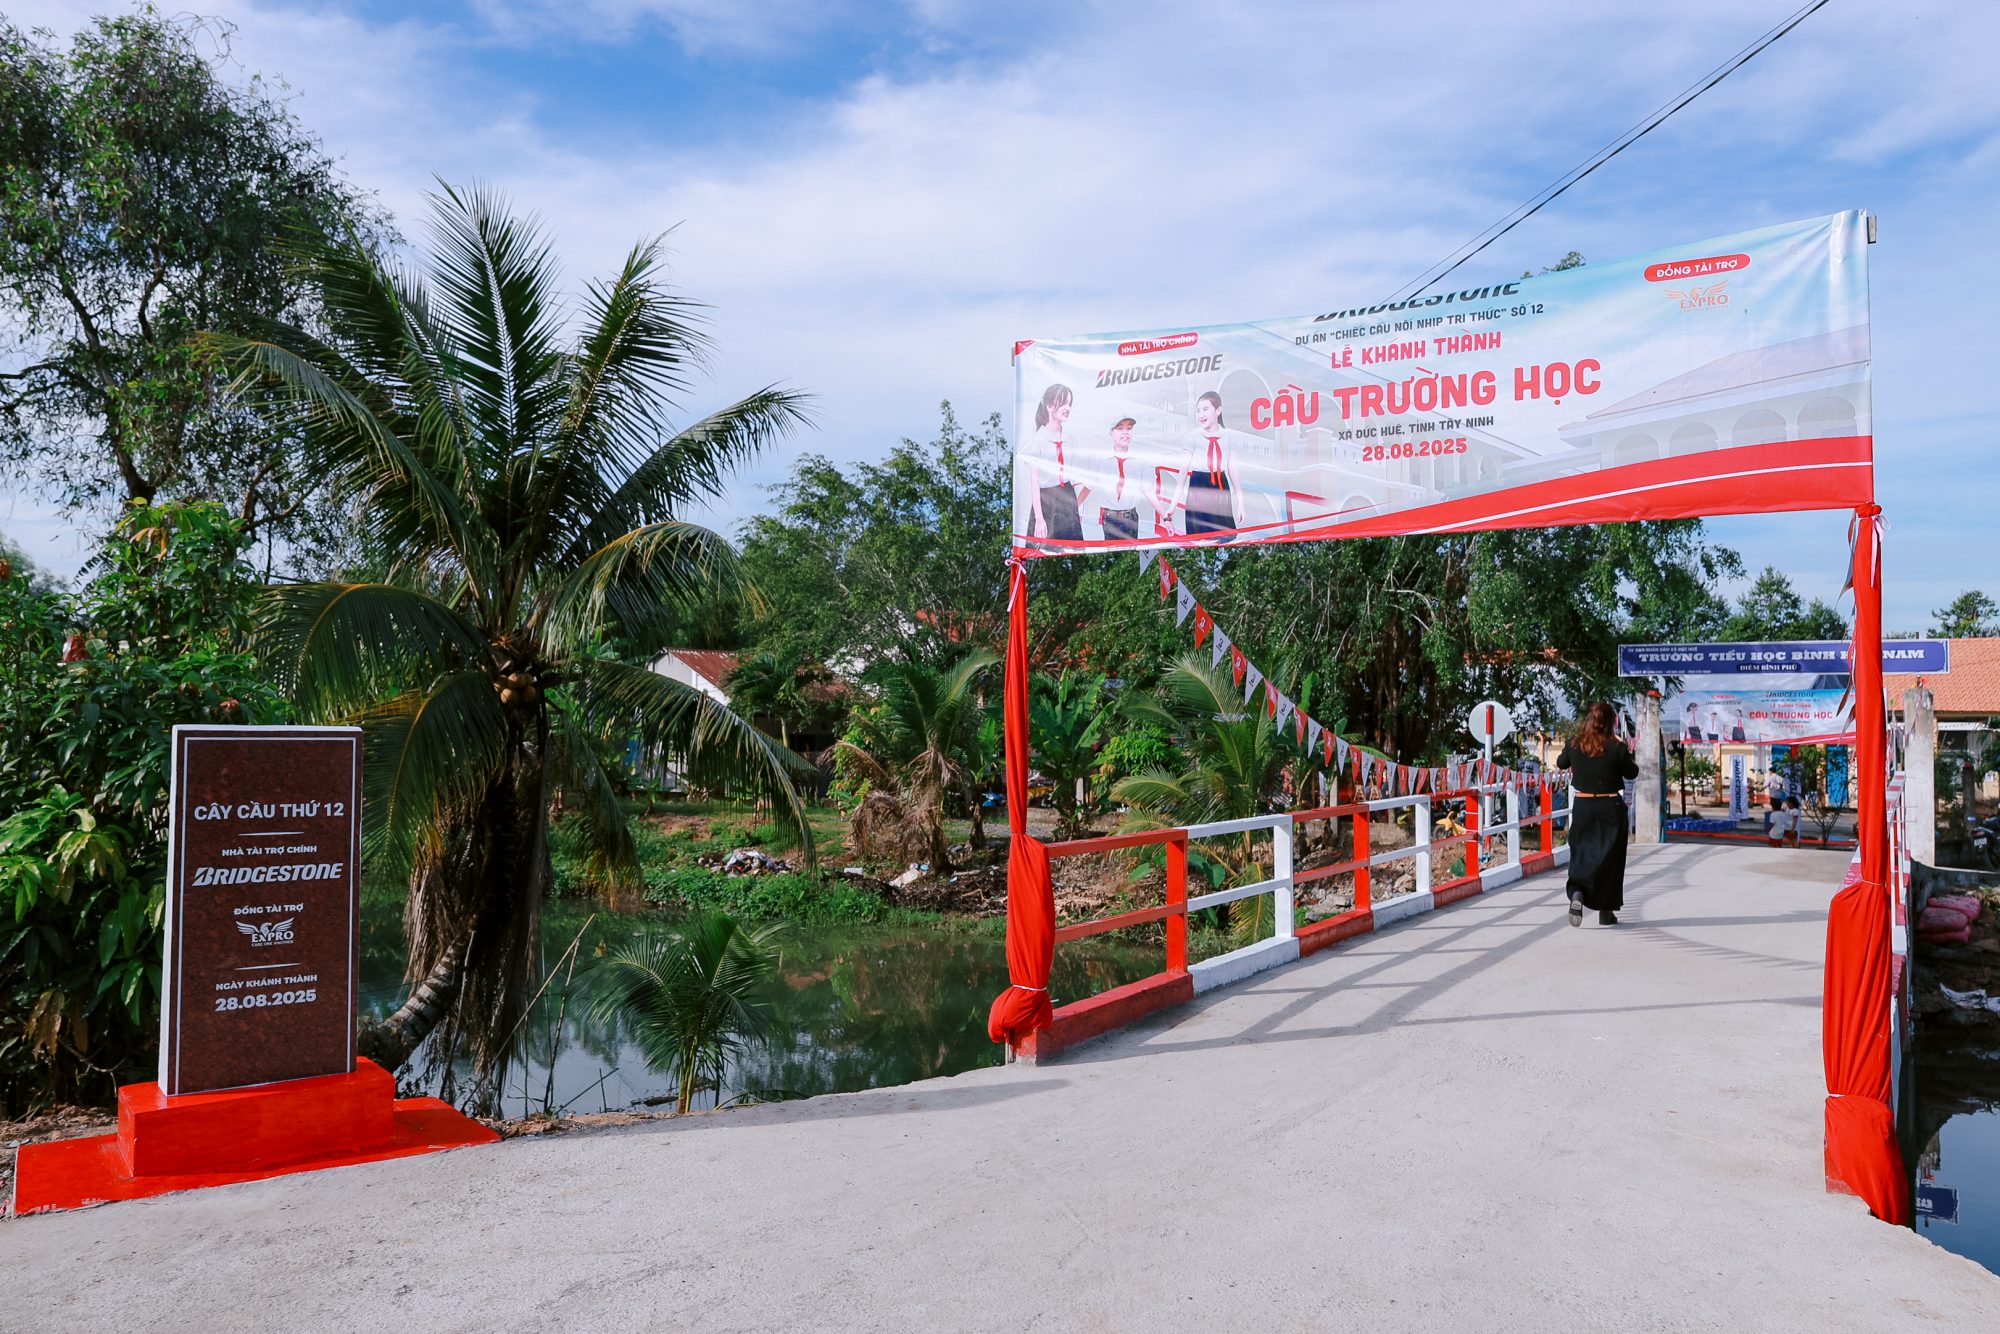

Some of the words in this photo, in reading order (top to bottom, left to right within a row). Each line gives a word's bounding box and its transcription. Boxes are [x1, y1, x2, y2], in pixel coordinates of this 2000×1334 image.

[1694, 262, 1712, 273] TÀI
[1715, 258, 1738, 271] TRỢ
[1680, 294, 1729, 310] EXPRO
[1448, 312, 1466, 324] TRI
[1532, 303, 1544, 314] 12
[1331, 343, 1353, 369] LỄ
[1361, 338, 1426, 365] KHÁNH
[1433, 328, 1502, 356] THÀNH
[1096, 354, 1223, 388] BRIDGESTONE
[1250, 382, 1320, 432] CẦU
[1333, 366, 1496, 422] TRƯỜNG
[1514, 358, 1602, 406] HỌC
[1356, 424, 1377, 439] ĐỨC
[1438, 417, 1462, 430] TÂY
[1466, 416, 1494, 428] NINH
[1362, 438, 1468, 462] 28.08.2025
[1750, 651, 1786, 662] HỌC
[1791, 648, 1835, 660] BÌNH
[1882, 649, 1924, 659] NAM
[194, 803, 232, 820] CÂY
[236, 800, 276, 819] CẦU
[280, 800, 320, 818] THỨ
[324, 802, 344, 816] 12
[222, 846, 244, 857] NHÀ
[246, 846, 262, 856] TÀI
[264, 846, 285, 856] TRỢ
[286, 844, 318, 854] CHÍNH
[192, 863, 344, 886] BRIDGESTONE
[265, 904, 282, 914] TÀI
[284, 902, 304, 913] TRỢ
[216, 980, 243, 991] NGÀY
[246, 977, 282, 988] KHÁNH
[284, 974, 318, 985] THÀNH
[214, 988, 317, 1012] 28.08.2025
